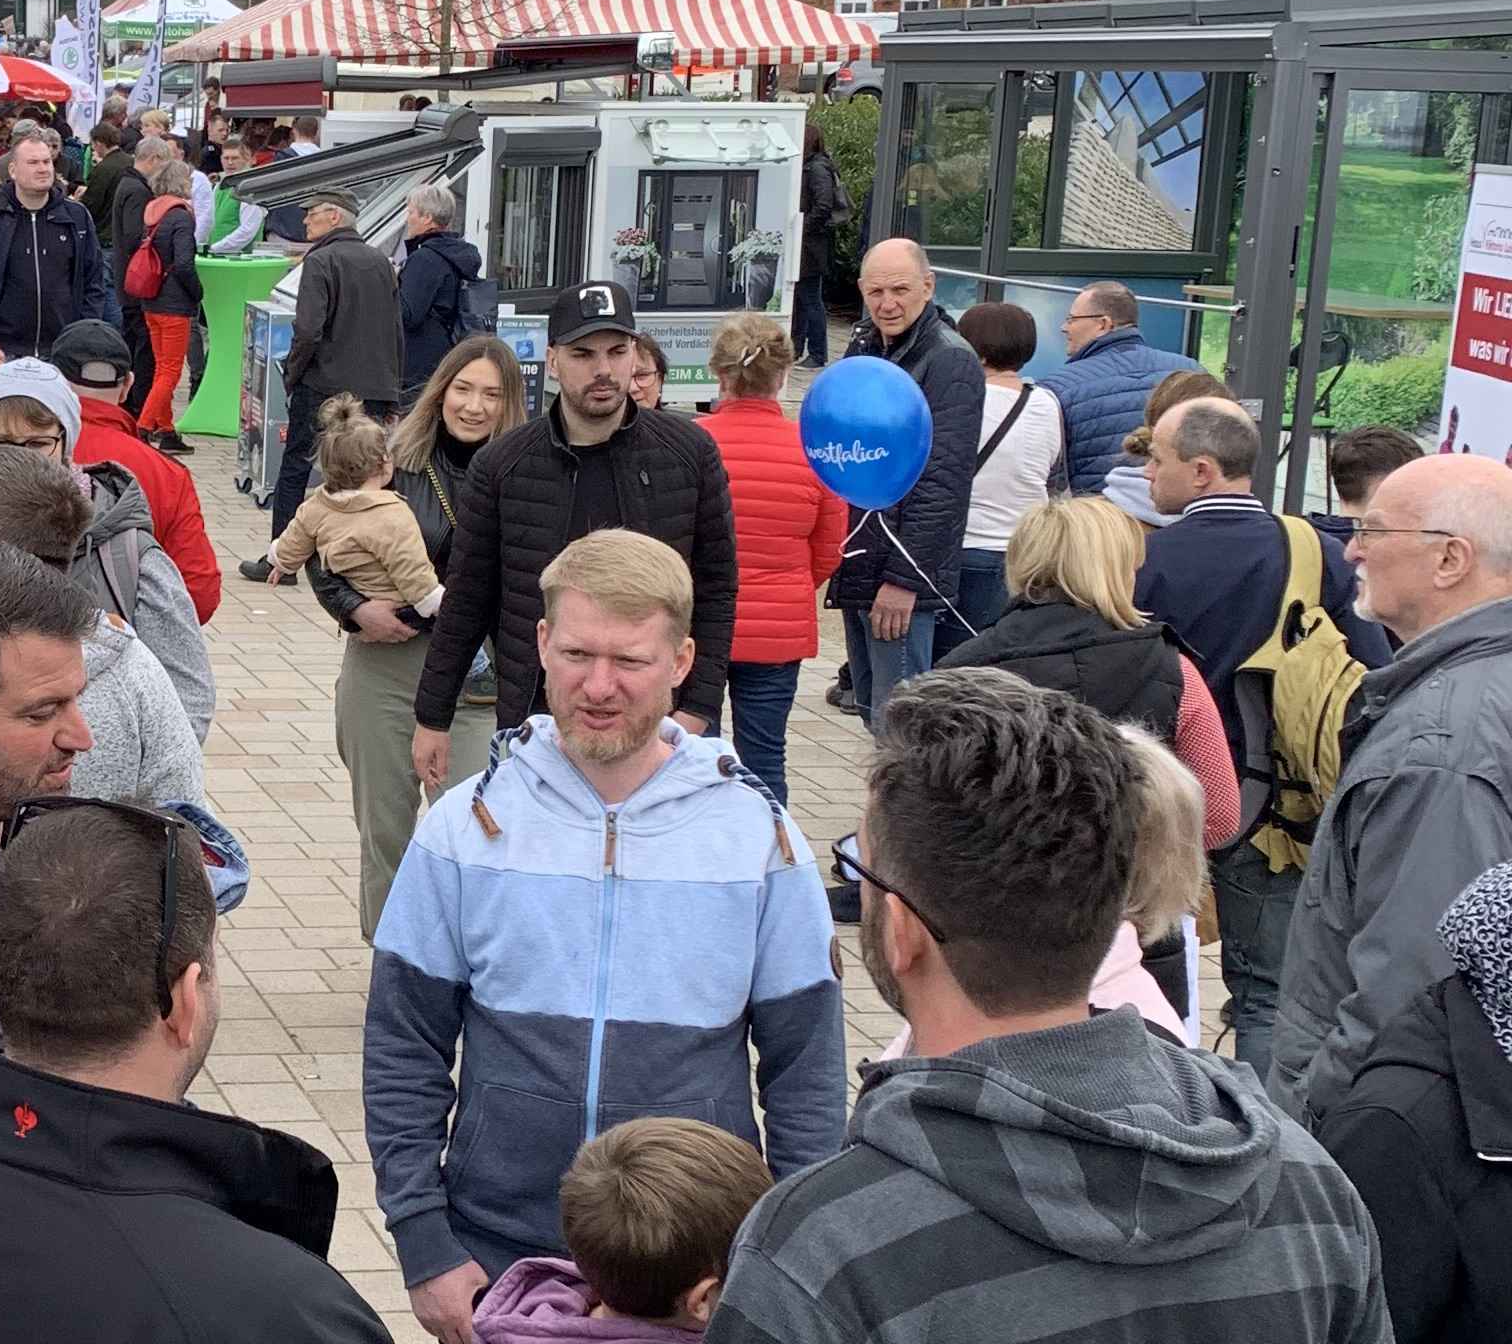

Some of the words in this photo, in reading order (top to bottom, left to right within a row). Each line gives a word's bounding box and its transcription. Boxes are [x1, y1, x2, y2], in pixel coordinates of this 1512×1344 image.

[1473, 287, 1494, 314] Wir
[1469, 338, 1493, 361] was
[1493, 340, 1510, 365] wir
[668, 368, 692, 380] EIM
[695, 368, 705, 380] &
[805, 439, 890, 472] westfalica
